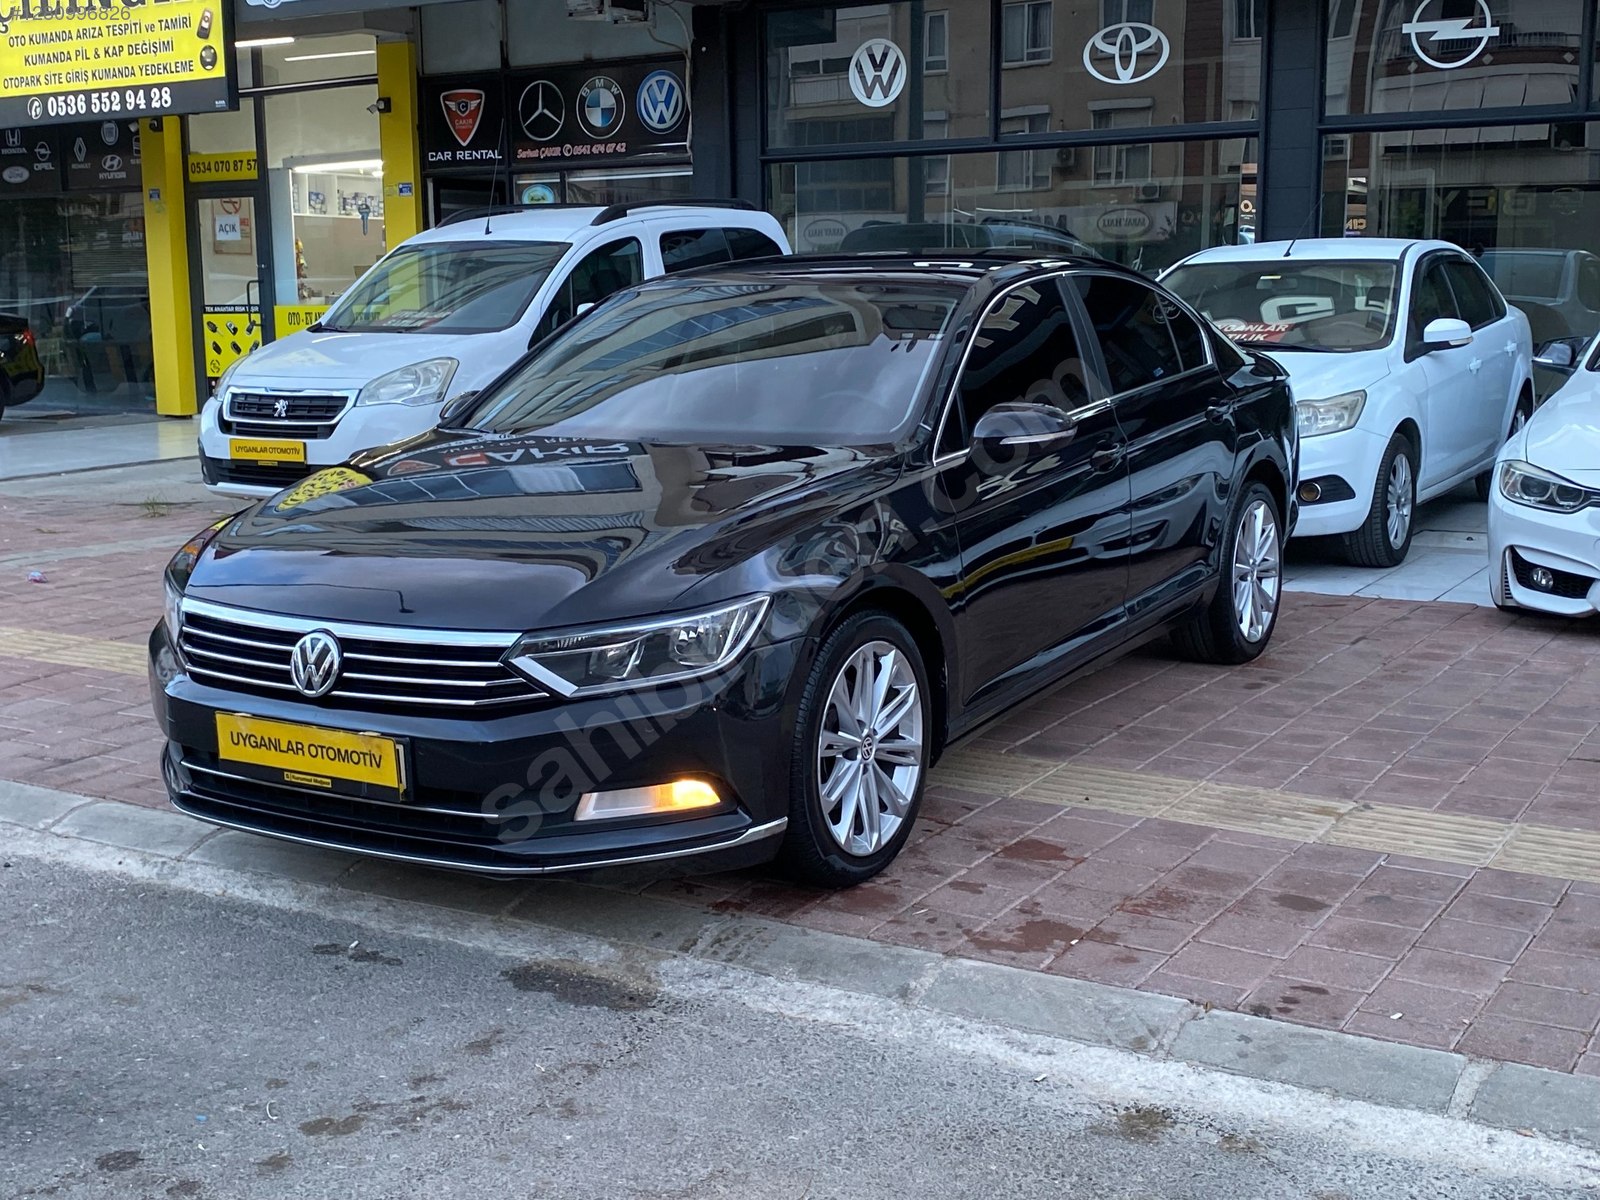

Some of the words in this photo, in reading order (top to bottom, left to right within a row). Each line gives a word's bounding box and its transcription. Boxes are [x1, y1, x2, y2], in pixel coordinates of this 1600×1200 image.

[9, 36, 26, 47] OTO
[29, 30, 73, 45] KUMANDA
[76, 26, 103, 40] ARIZA
[106, 21, 142, 37] TESPİTİ
[158, 16, 192, 30] TAMİRİ
[25, 49, 72, 66] KUMANDA
[75, 46, 90, 61] PİL
[93, 48, 101, 59] &
[104, 45, 124, 58] KAP
[128, 39, 174, 57] DEĞİŞİMİ
[3, 73, 42, 89] OTOPARK
[44, 71, 63, 85] SİTE
[65, 68, 89, 84] GİRİŞ
[91, 64, 136, 80] KUMANDA
[138, 60, 194, 77] YEDEKLEME
[48, 94, 87, 117] 0536
[91, 91, 121, 113] 552
[125, 89, 146, 110] 94
[150, 86, 172, 109] 28
[428, 151, 452, 161] CAR
[456, 149, 502, 160] RENTAL
[191, 160, 212, 174] 0534
[214, 159, 231, 173] 070
[233, 158, 244, 172] 87
[246, 158, 257, 171] 57
[218, 224, 237, 236] AÇIK
[288, 312, 300, 325] OTO
[304, 312, 313, 325] EV
[1216, 324, 1289, 332] YGANLAR
[235, 445, 268, 454] UYGANLAR
[268, 446, 300, 455] OTOMOTİV
[230, 731, 304, 756] UYGANLAR
[307, 744, 383, 769] OTOMOTİV
